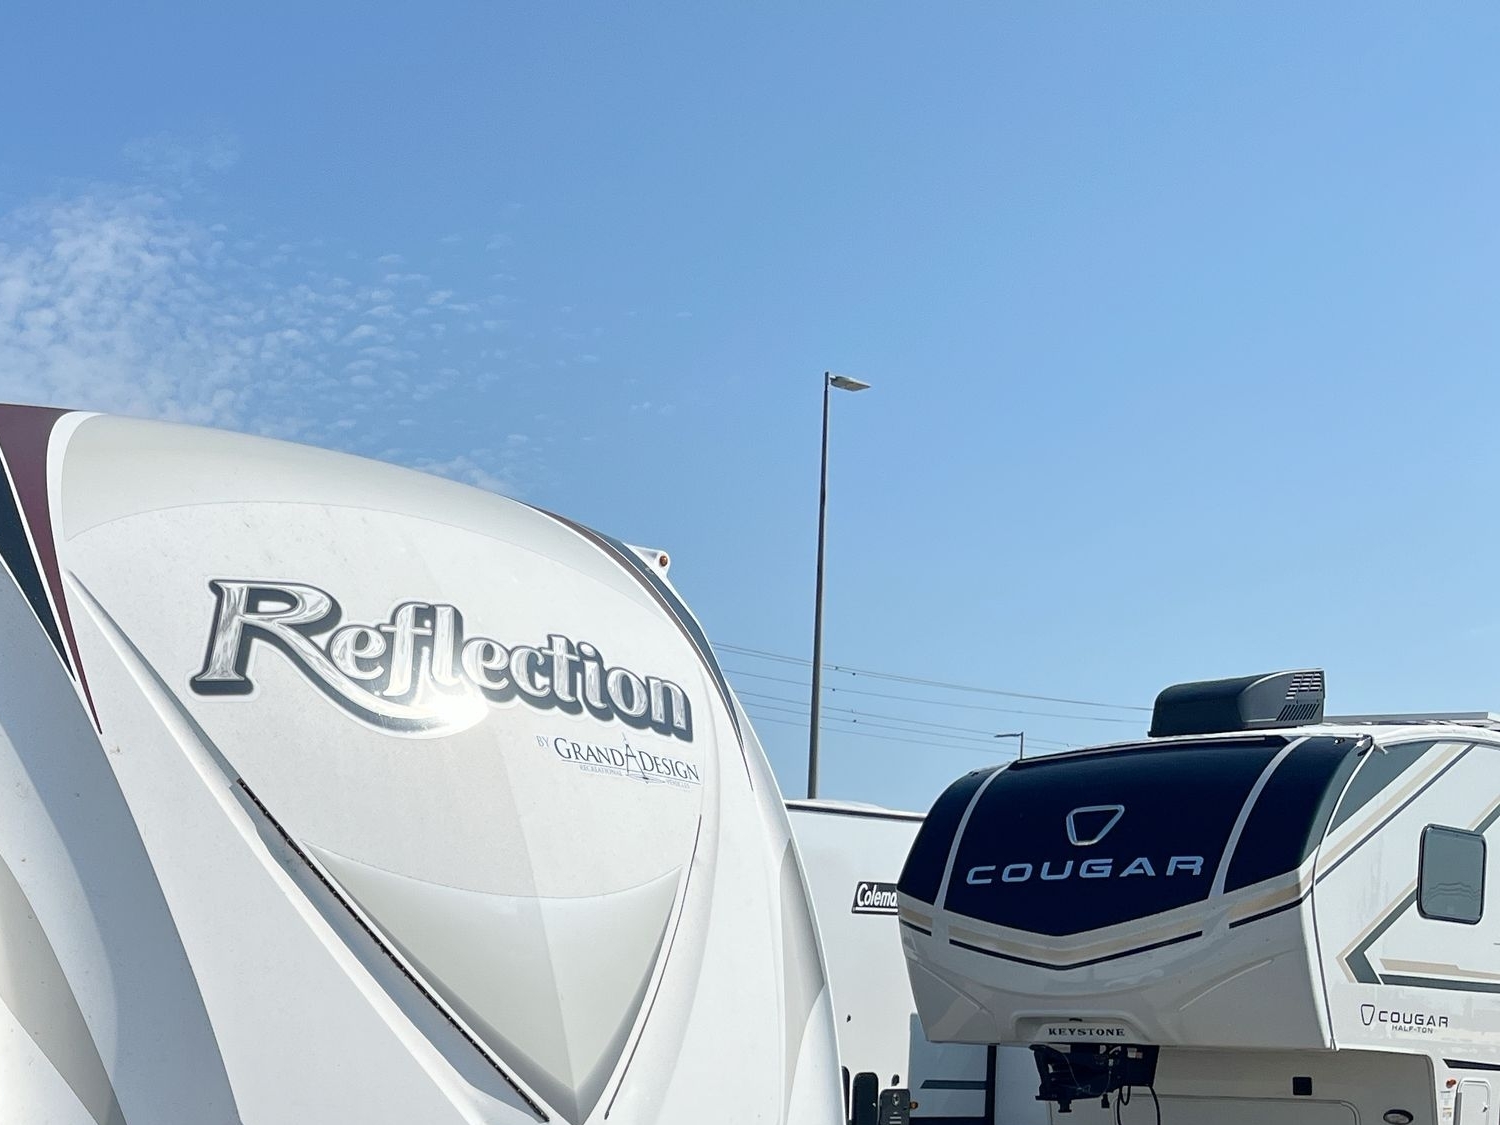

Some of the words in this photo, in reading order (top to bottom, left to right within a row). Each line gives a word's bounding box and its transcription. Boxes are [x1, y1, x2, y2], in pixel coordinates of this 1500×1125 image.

[190, 579, 694, 741] Reflection
[536, 735, 549, 748] BY
[553, 737, 625, 767] GRAND
[639, 750, 699, 781] DESIGN
[966, 856, 1204, 885] COUGAR
[857, 883, 898, 907] Colema
[1378, 1010, 1448, 1028] COUGAR
[1392, 1025, 1434, 1034] HALF-TON
[1048, 1027, 1126, 1037] KEYSTONE
